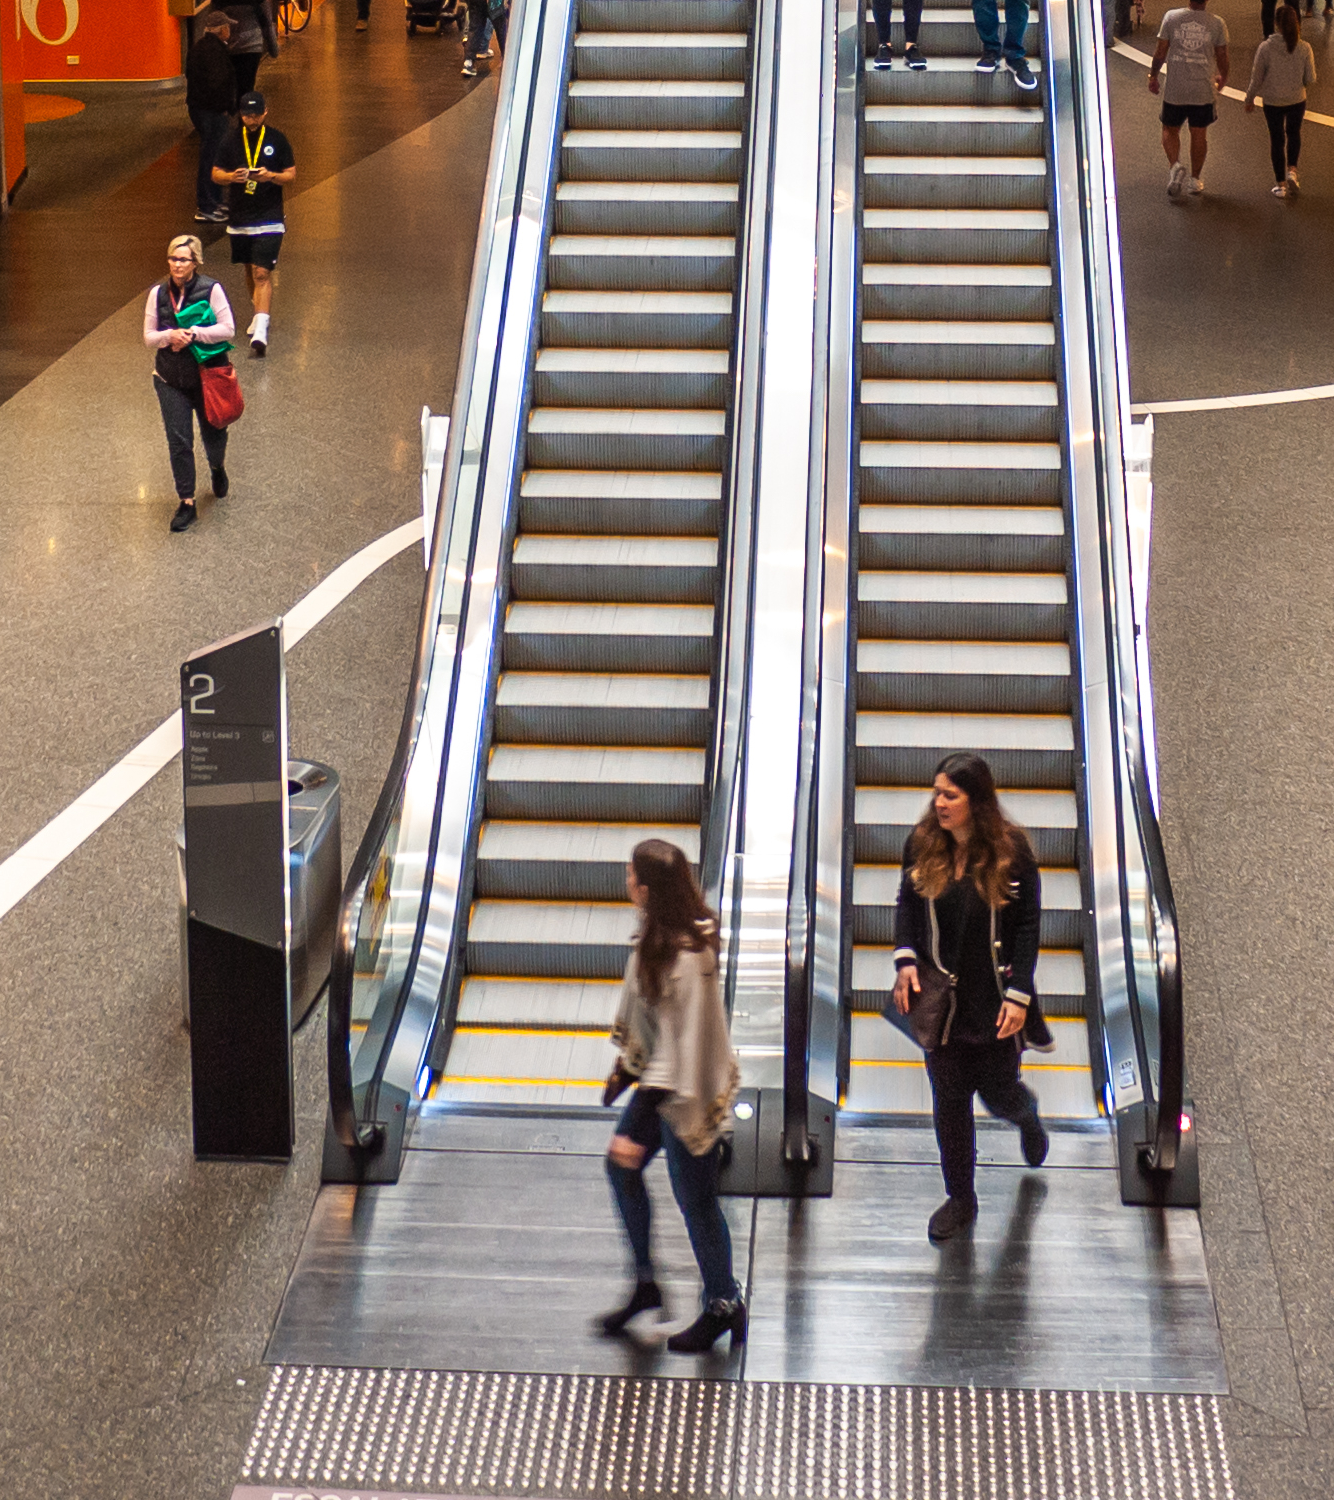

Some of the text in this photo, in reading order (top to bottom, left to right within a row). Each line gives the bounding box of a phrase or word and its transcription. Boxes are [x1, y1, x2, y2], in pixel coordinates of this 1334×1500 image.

[189, 673, 215, 714] 2
[189, 730, 201, 740] Up
[212, 730, 233, 739] Level
